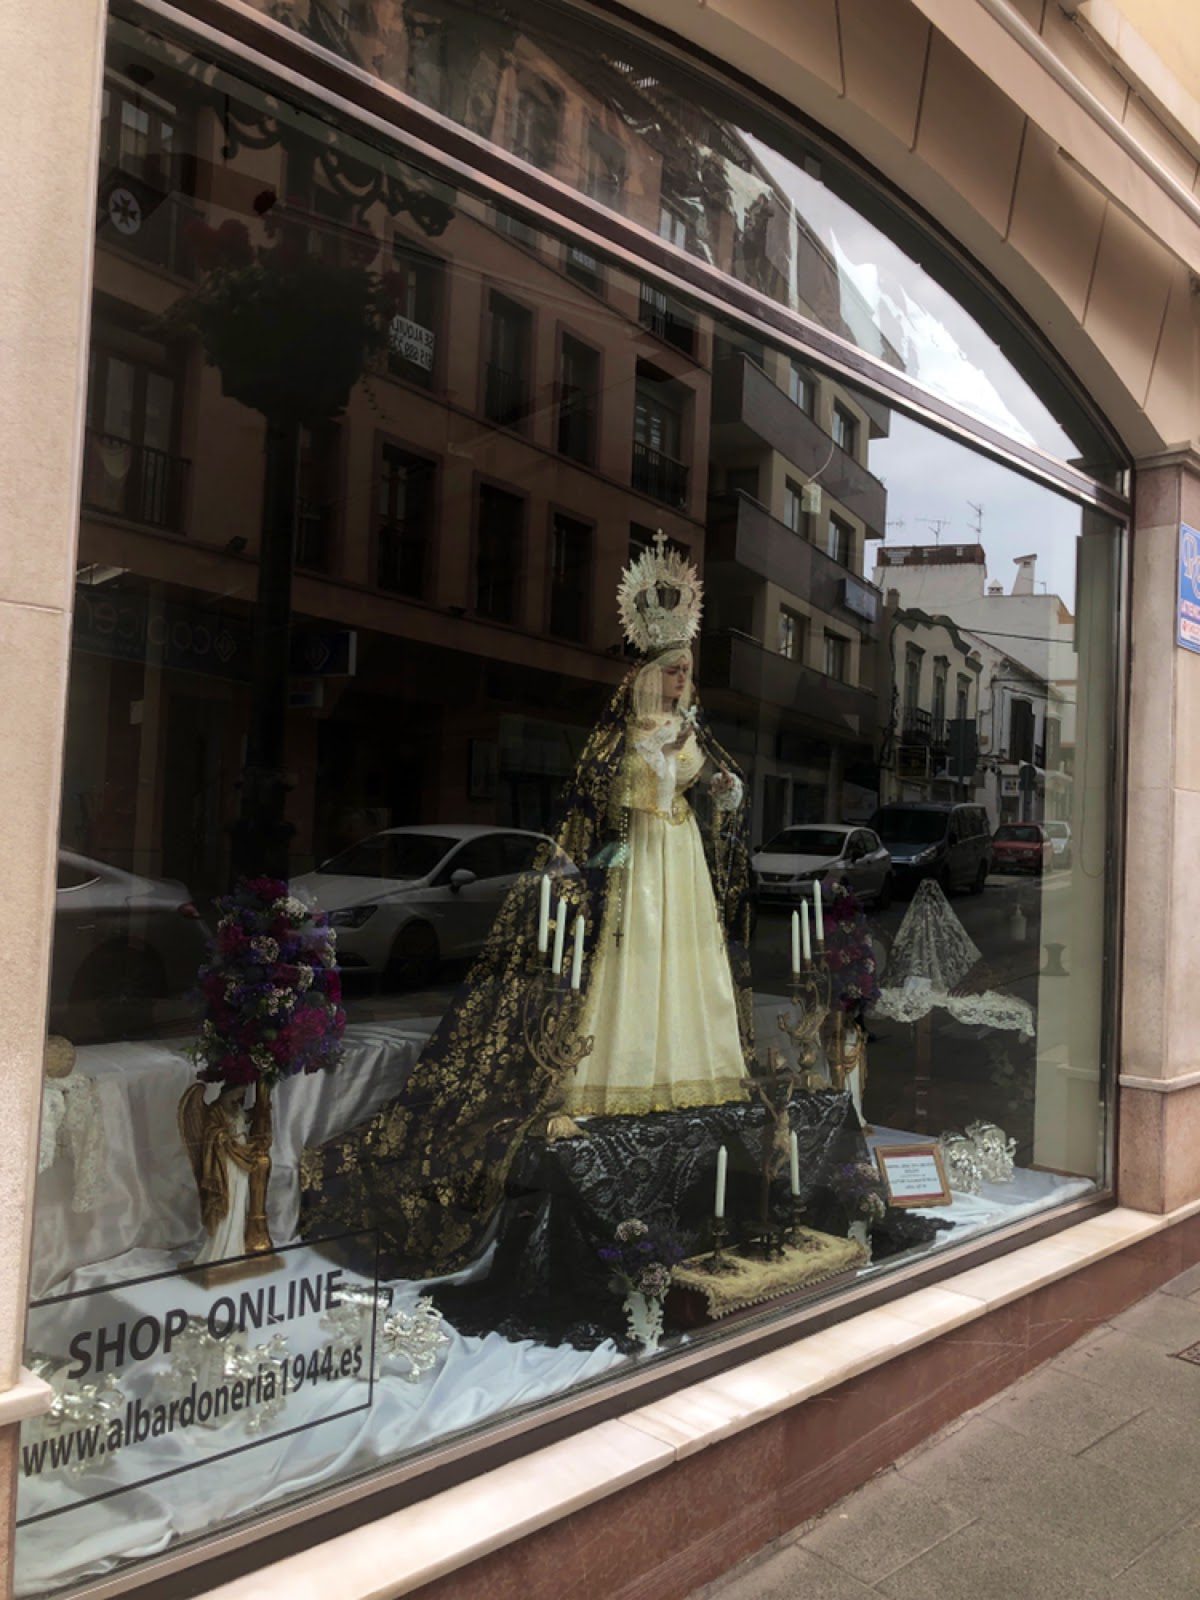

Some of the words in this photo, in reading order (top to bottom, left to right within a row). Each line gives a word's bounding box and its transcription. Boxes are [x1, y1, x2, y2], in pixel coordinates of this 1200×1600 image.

[68, 1309, 188, 1379] SHOP
[207, 1270, 343, 1339] ONLINE
[23, 1343, 362, 1476] www.albardoneria1944.es
